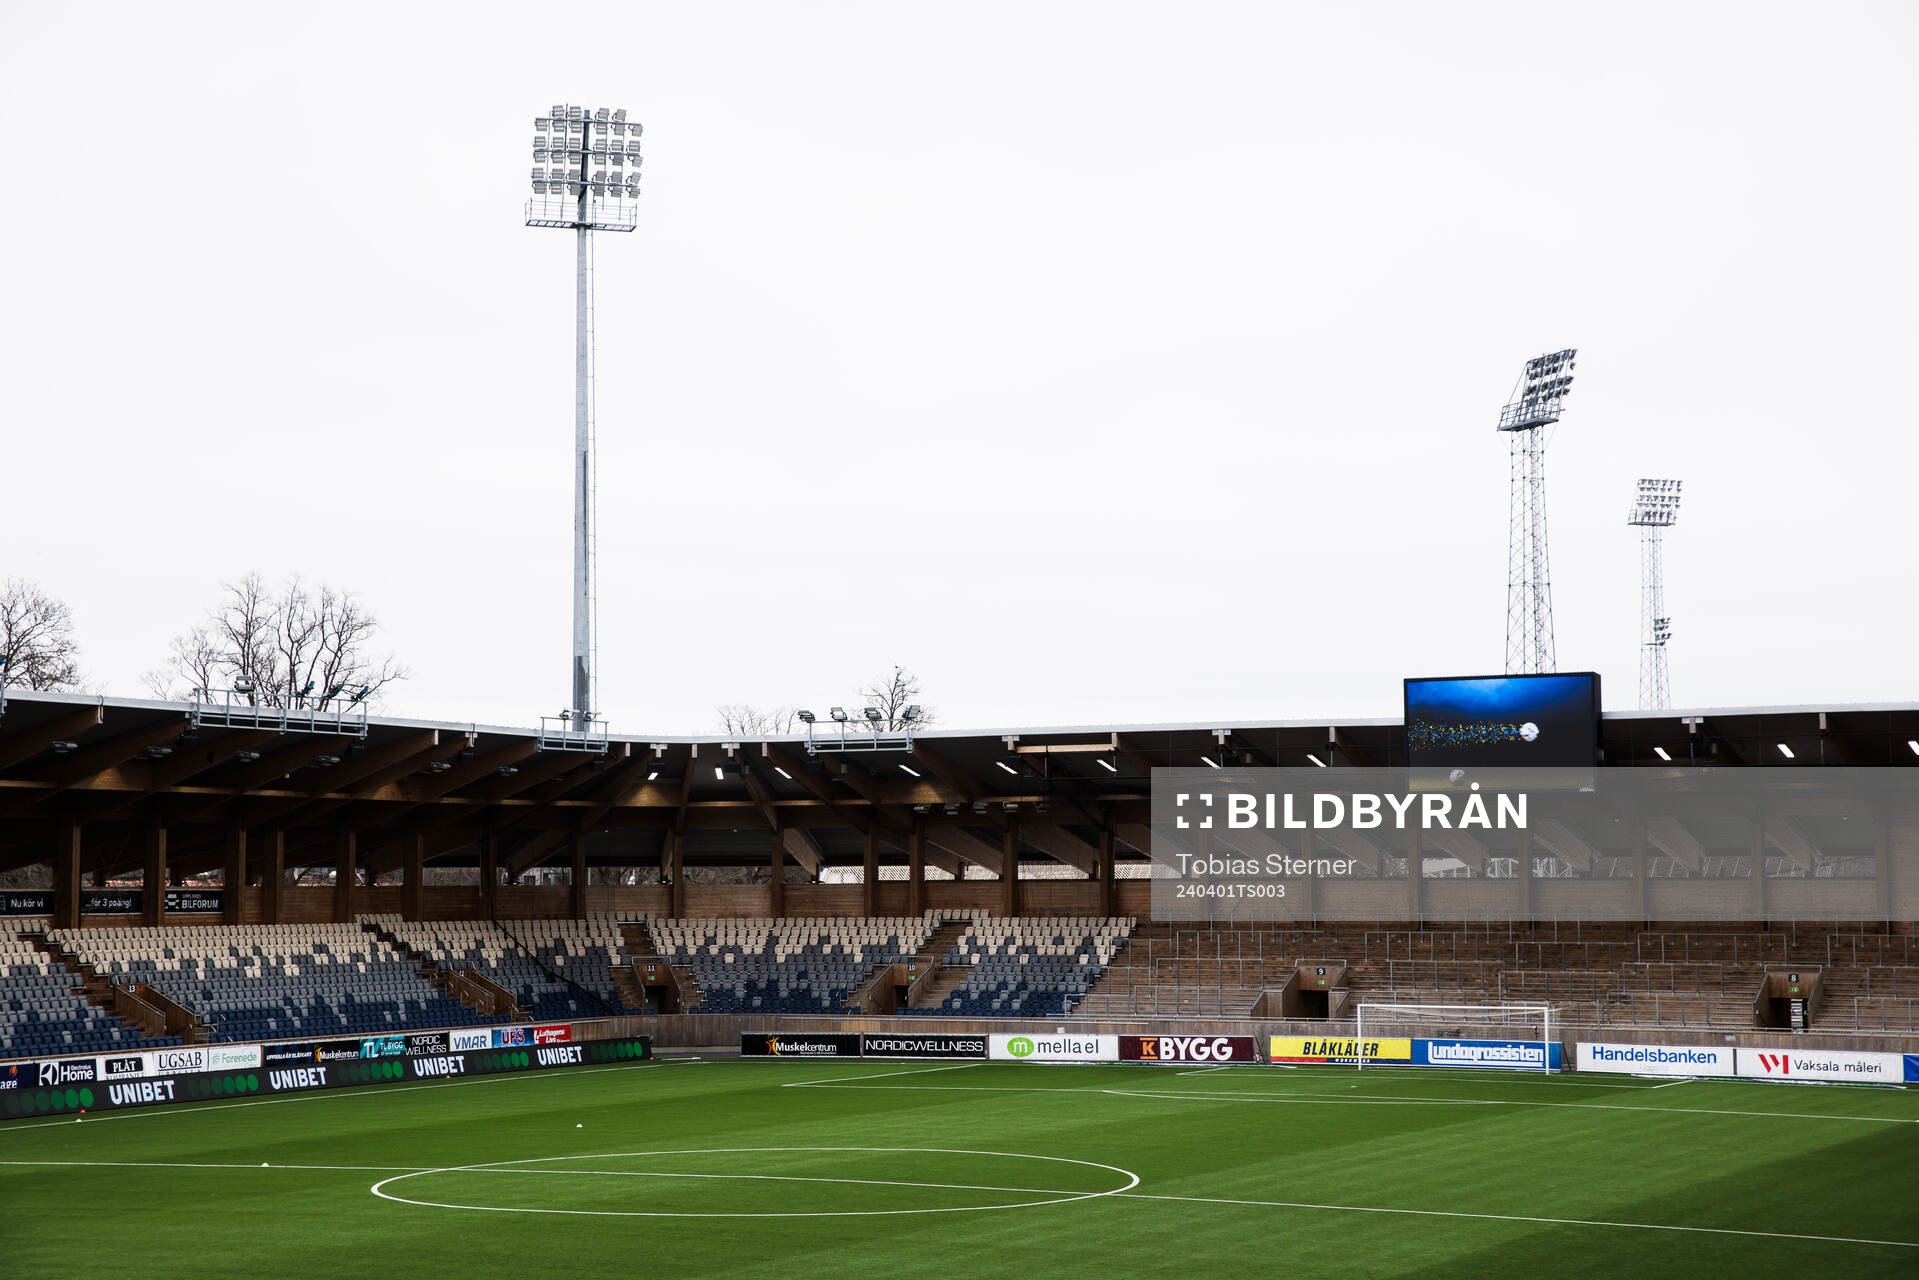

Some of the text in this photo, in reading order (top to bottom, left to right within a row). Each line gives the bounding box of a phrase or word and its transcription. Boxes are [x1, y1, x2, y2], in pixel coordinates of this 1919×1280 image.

[10, 898, 44, 908] Nu kör vi
[102, 898, 107, 907] 3
[182, 899, 219, 909] BILFORUM
[412, 1035, 441, 1046] NORDIC
[453, 1035, 487, 1050] VMAR
[502, 1028, 525, 1045] UFS
[387, 1041, 404, 1050] BYGG
[405, 1044, 447, 1056] WELLNESS
[776, 1041, 838, 1053] Muskelcentrum
[1037, 1039, 1099, 1055] mella el
[159, 1051, 203, 1069] UGSAB
[222, 1053, 257, 1064] Forenede
[537, 1046, 582, 1066] UNIBET
[1592, 1046, 1717, 1063] Handelsbanken
[112, 1059, 137, 1072] PLÅT
[413, 1056, 465, 1077] UNIBET
[1794, 1057, 1882, 1074] Vaksala måleri
[61, 1065, 94, 1082] Home
[270, 1067, 327, 1090] UNIBET
[109, 1080, 175, 1105] UNIBET
